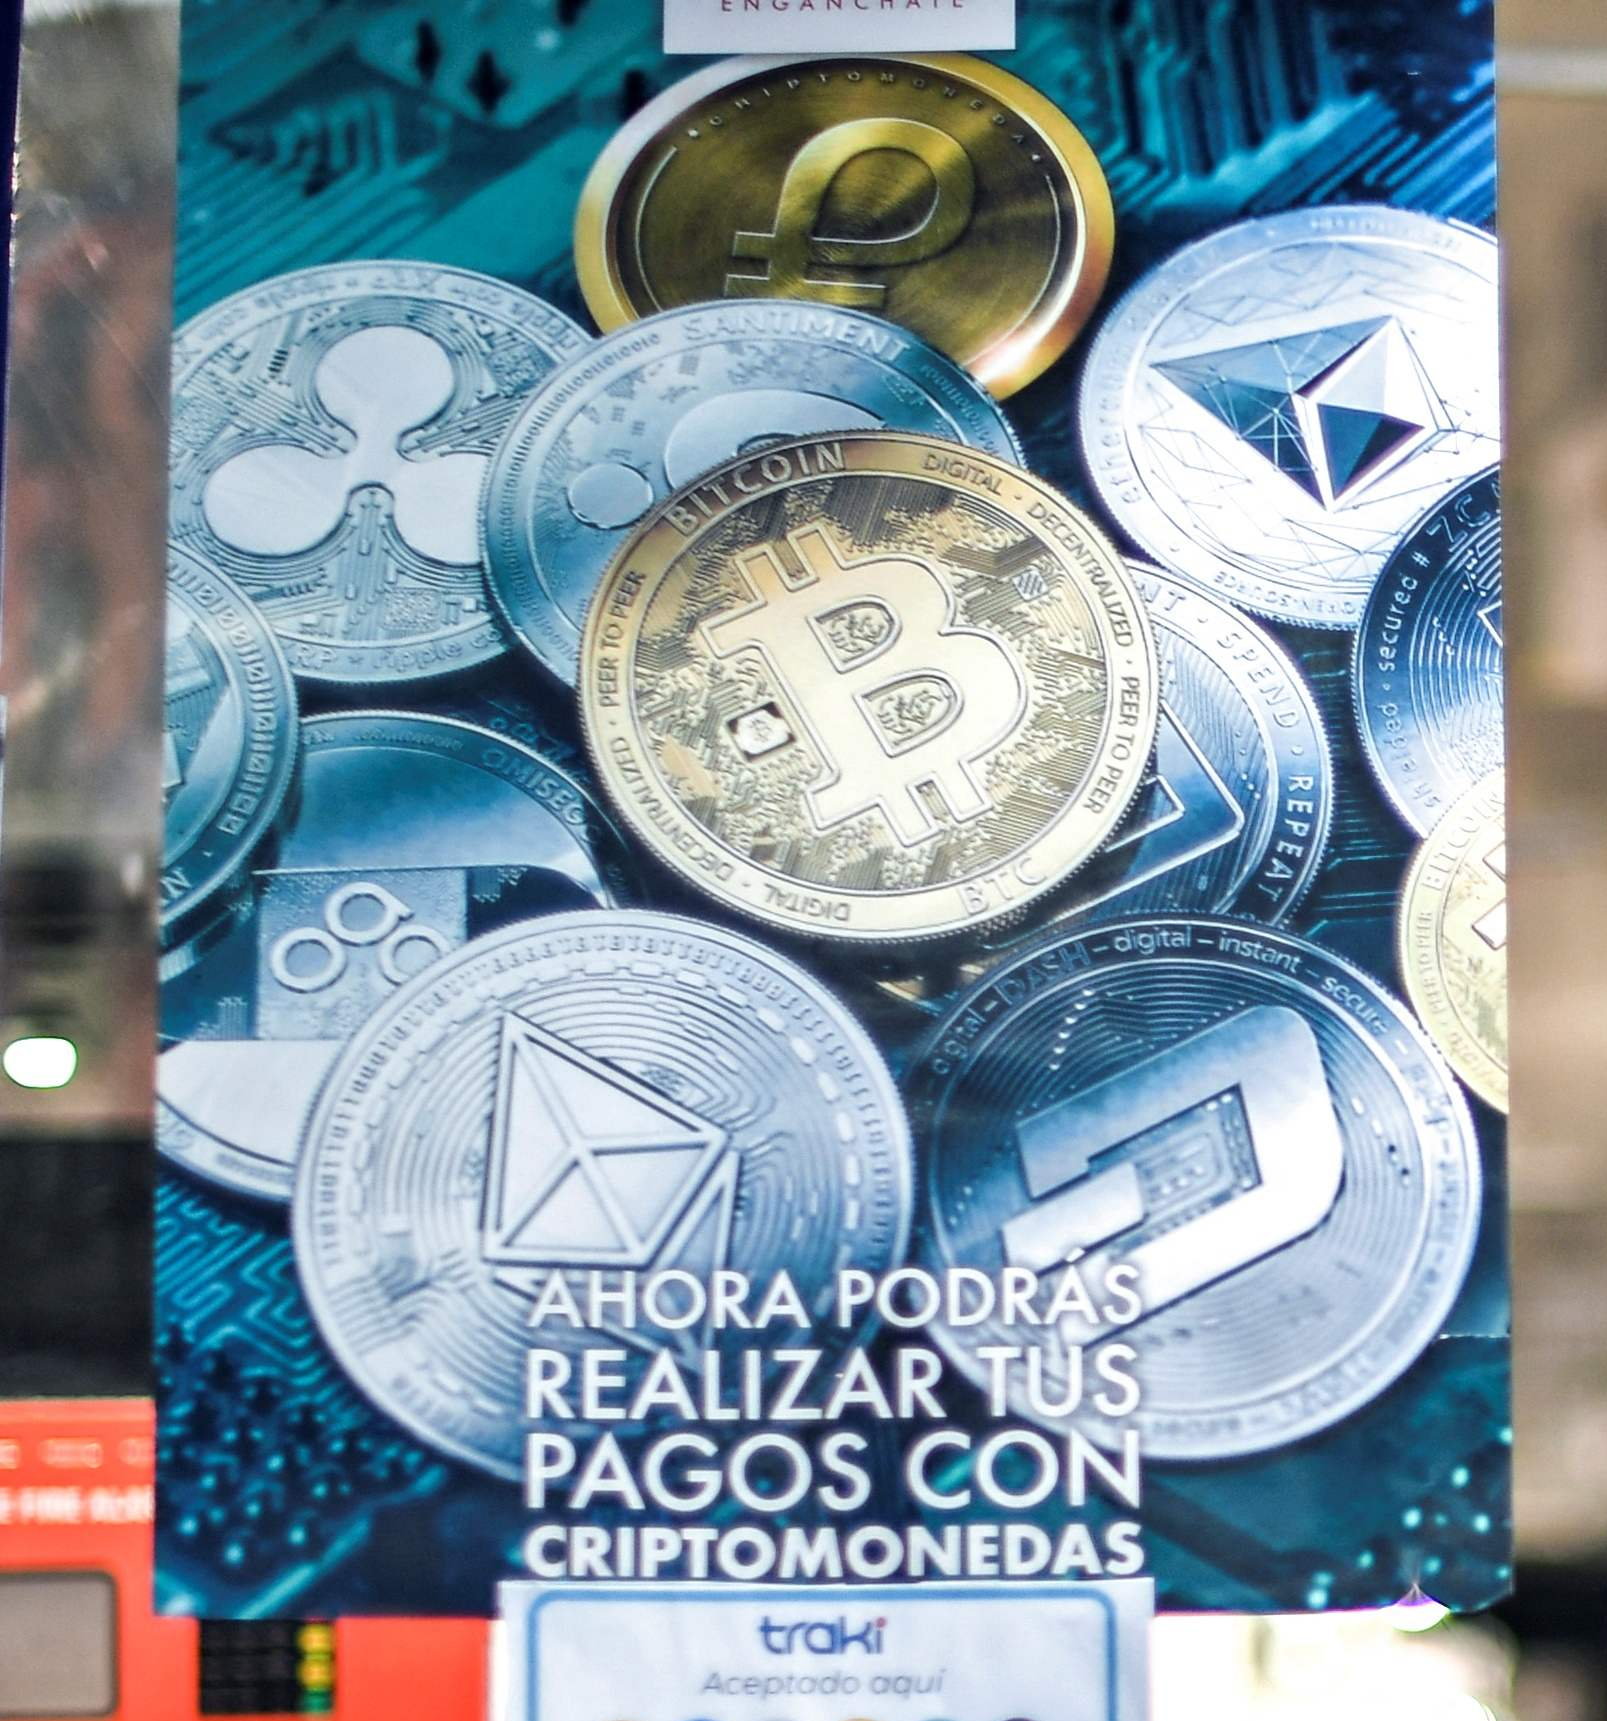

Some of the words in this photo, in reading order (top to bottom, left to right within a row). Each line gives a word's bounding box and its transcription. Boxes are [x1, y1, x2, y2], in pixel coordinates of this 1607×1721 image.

[682, 306, 911, 361] SANTIMENT
[663, 442, 848, 537] BITCOIN
[920, 453, 1003, 497] DIGITAL
[608, 570, 648, 620] PEER
[1026, 502, 1135, 648] DECENTRALIZED
[601, 622, 624, 651] TO
[598, 657, 621, 707] PEER
[1118, 675, 1140, 728] PEER
[1215, 631, 1302, 730] SPEND
[1110, 733, 1135, 762] TO
[608, 736, 736, 883] DECENTRALIZED
[1083, 764, 1124, 816] PEER
[1257, 773, 1315, 903] REPEAT
[763, 881, 852, 922] DIGITAL
[957, 855, 1049, 916] BTC
[1113, 925, 1192, 957] digital
[1218, 930, 1302, 974] instant
[1319, 975, 1390, 1034] secure
[528, 1267, 812, 1331] AHORA
[838, 1248, 1143, 1331] PODRÁS
[527, 1346, 948, 1422] REALIZAR
[977, 1343, 1142, 1419] TUS
[527, 1430, 871, 1513] PAGOS
[908, 1428, 1140, 1511] CON
[523, 1522, 1145, 1580] CRIPTOMONEDAS
[759, 1615, 888, 1655] traki
[699, 1671, 862, 1698] Aceptado
[868, 1668, 947, 1699] aquí
